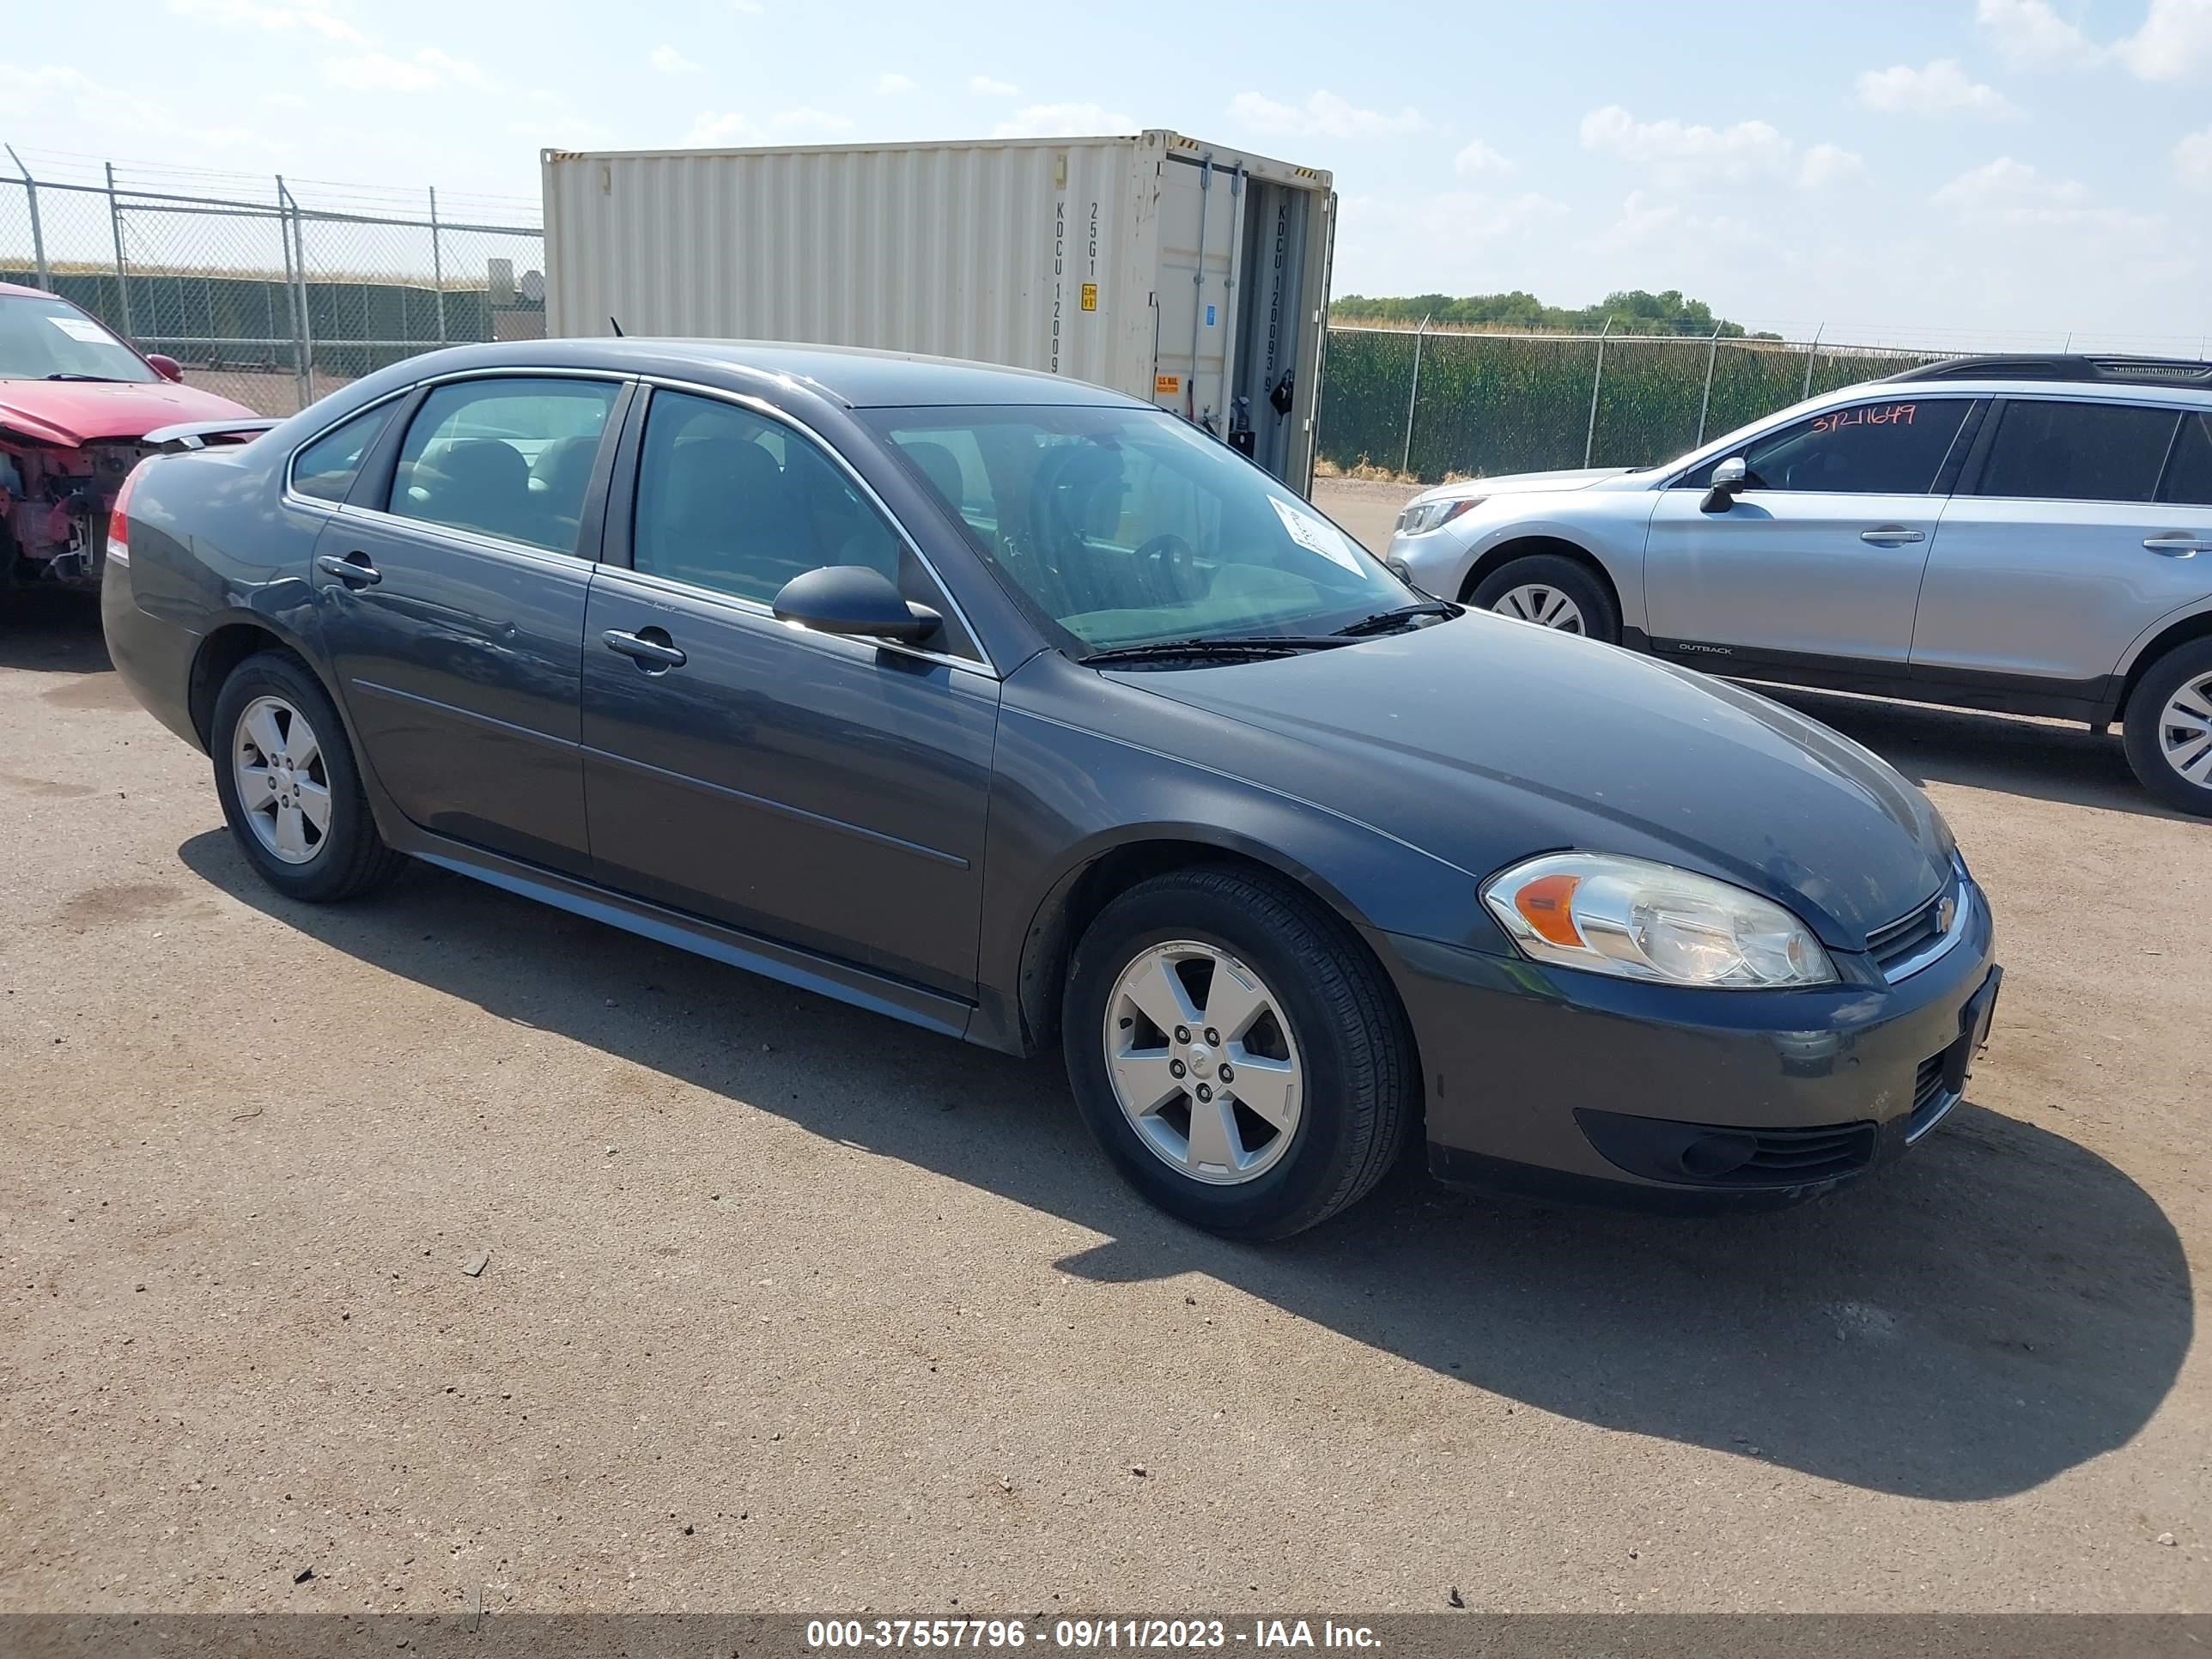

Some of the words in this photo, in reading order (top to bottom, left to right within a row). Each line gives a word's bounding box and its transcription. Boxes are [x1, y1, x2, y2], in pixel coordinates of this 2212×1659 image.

[1055, 202, 1064, 276] KDCU
[1089, 202, 1098, 276] 25G1
[1274, 205, 1286, 270] KDCU
[1051, 283, 1060, 374] 12009
[1679, 643, 1732, 654] OUTBACK
